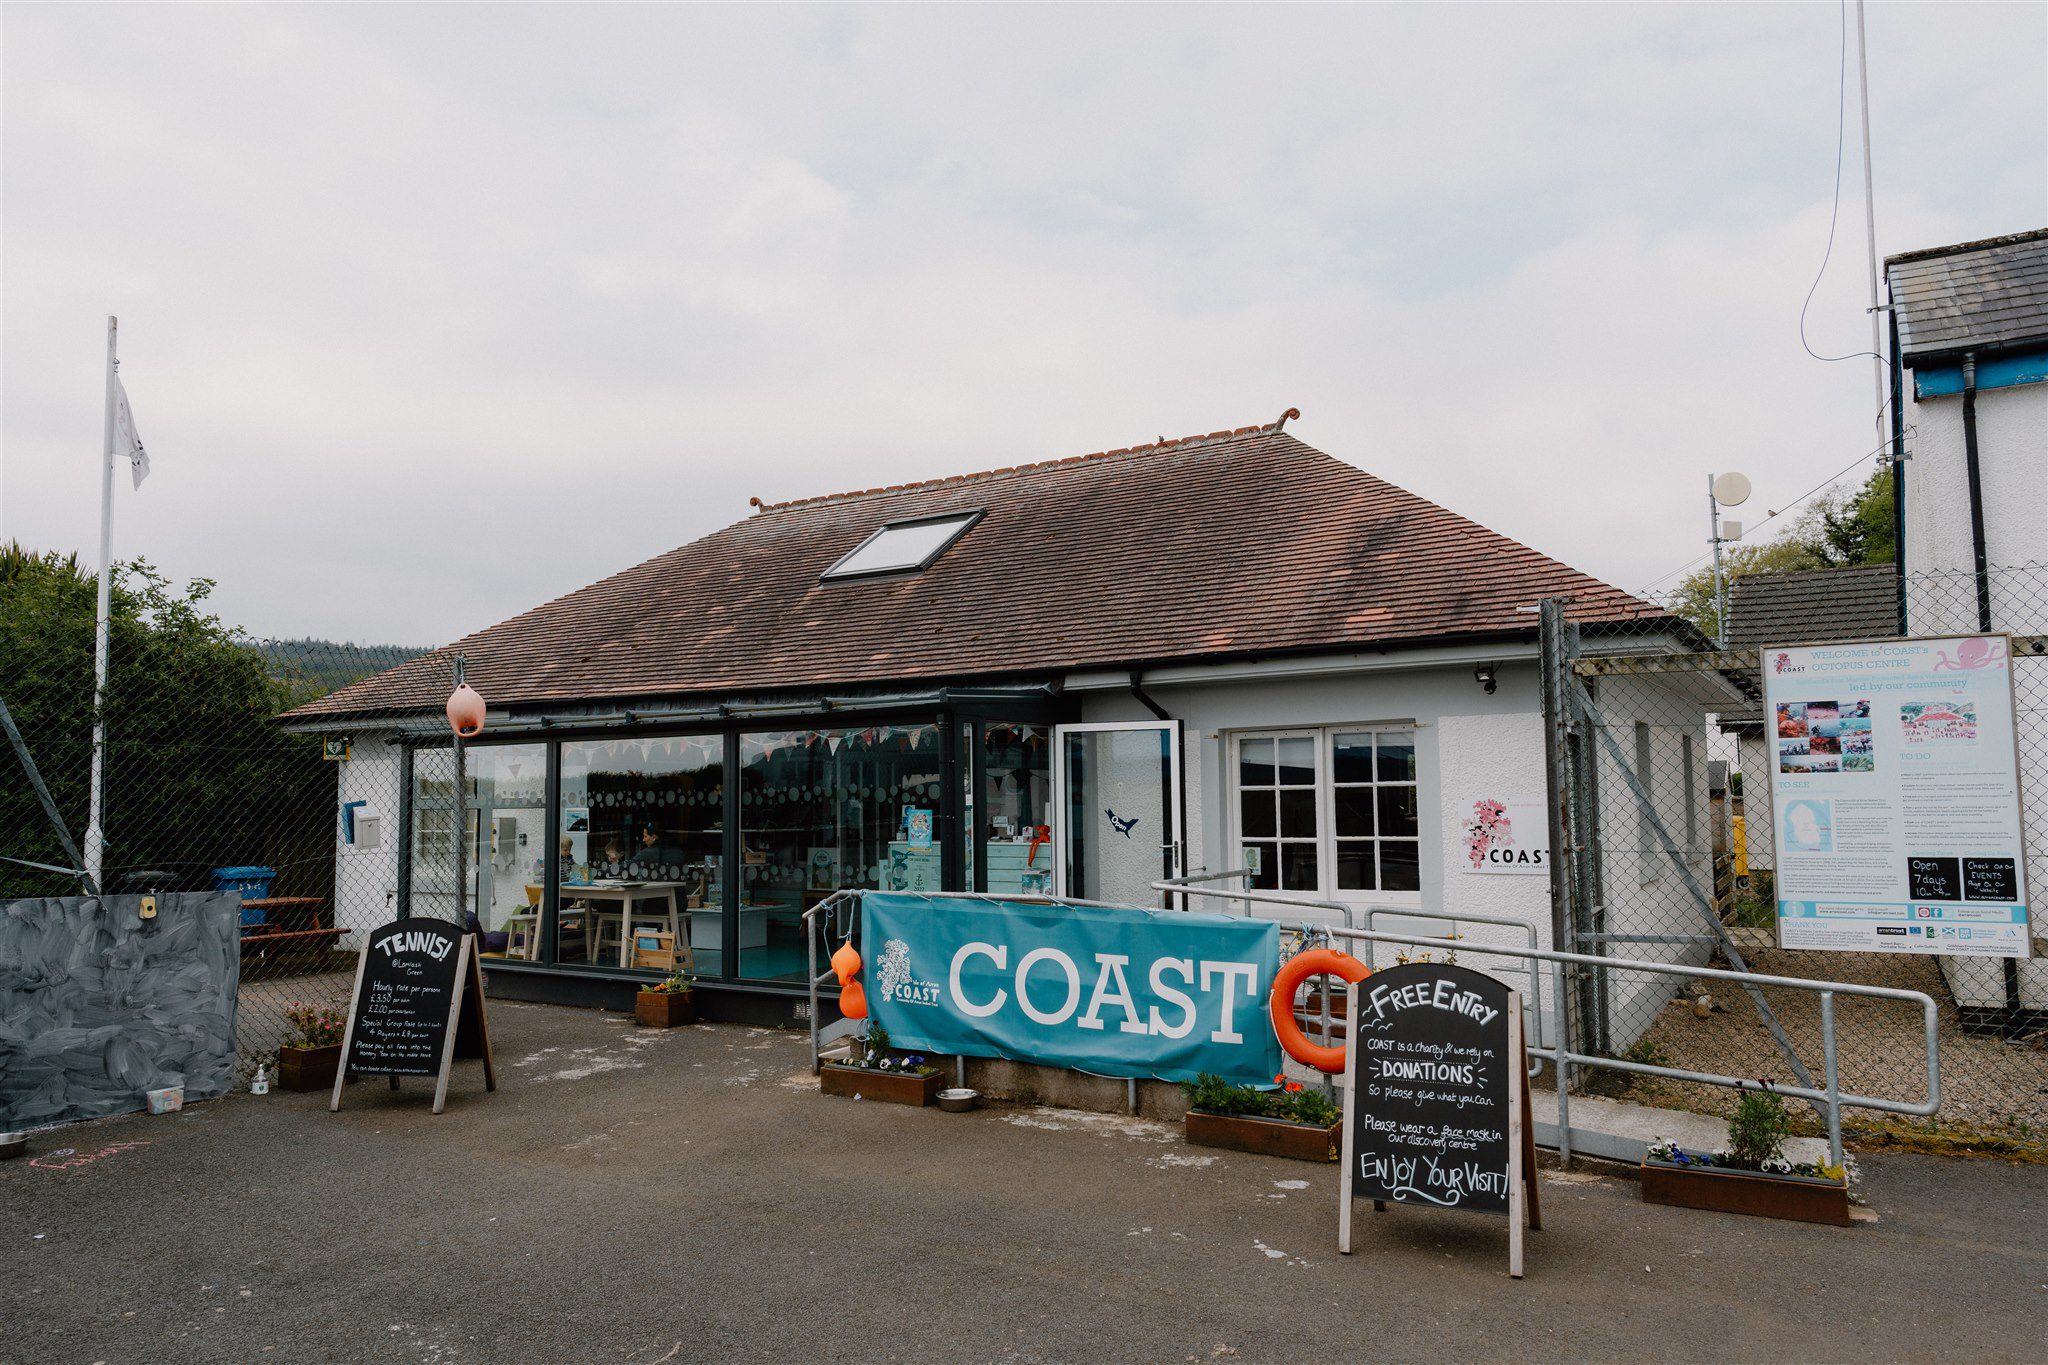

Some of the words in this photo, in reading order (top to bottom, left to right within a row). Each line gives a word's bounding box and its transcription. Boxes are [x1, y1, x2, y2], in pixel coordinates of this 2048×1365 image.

[1811, 648, 1869, 660] WELCOME
[1871, 649, 1880, 657] to
[1883, 646, 1929, 656] COAST's
[1812, 661, 1863, 672] OCTOPUS
[1865, 658, 1910, 669] CENTRE
[1849, 683, 1867, 692] led
[1869, 682, 1883, 693] by
[1886, 682, 1903, 690] our
[1908, 679, 1968, 690] community
[1916, 752, 1931, 760] DO
[1792, 781, 1809, 789] SEE
[1111, 816, 1127, 831] Open
[1913, 861, 1938, 872] Open
[1968, 861, 1989, 870] Check
[1971, 871, 2002, 879] EVENTS
[1914, 874, 1921, 883] 7
[1922, 874, 1947, 891] days
[1785, 921, 1810, 929] THANK
[374, 931, 453, 963] TENNIS!
[391, 958, 422, 970] @Lamlash
[406, 968, 423, 976] Green
[372, 980, 393, 996] Hourly
[396, 984, 409, 992] rate
[410, 986, 420, 996] per
[896, 984, 940, 1003] COAST
[949, 941, 1259, 1045] COAST
[1370, 983, 1432, 1019] FREE
[1432, 979, 1499, 1027] ENTRY
[362, 1016, 383, 1029] Special
[386, 1019, 402, 1028] Group
[377, 1030, 396, 1041] Players
[355, 1040, 374, 1049] Please
[1367, 1038, 1395, 1051] COAST
[1398, 1042, 1406, 1051] is
[1407, 1043, 1415, 1051] a
[1415, 1041, 1444, 1060] charity
[1445, 1042, 1453, 1054] &
[1454, 1047, 1465, 1055] we
[1466, 1047, 1482, 1065] rely
[1484, 1049, 1495, 1058] on
[1382, 1061, 1473, 1085] DONATIONS
[1385, 1086, 1413, 1101] please
[1417, 1089, 1436, 1107] give
[1437, 1091, 1457, 1103] what
[1458, 1095, 1475, 1109] you
[1364, 1114, 1397, 1133] Please
[1400, 1122, 1426, 1136] wear
[1427, 1125, 1438, 1136] a
[1440, 1124, 1463, 1140] face
[1466, 1128, 1490, 1141] mask
[1491, 1130, 1503, 1140] in
[1388, 1133, 1405, 1144] our
[1407, 1135, 1447, 1155] discovery
[1448, 1139, 1478, 1150] centre
[1422, 1155, 1468, 1197] YOUR
